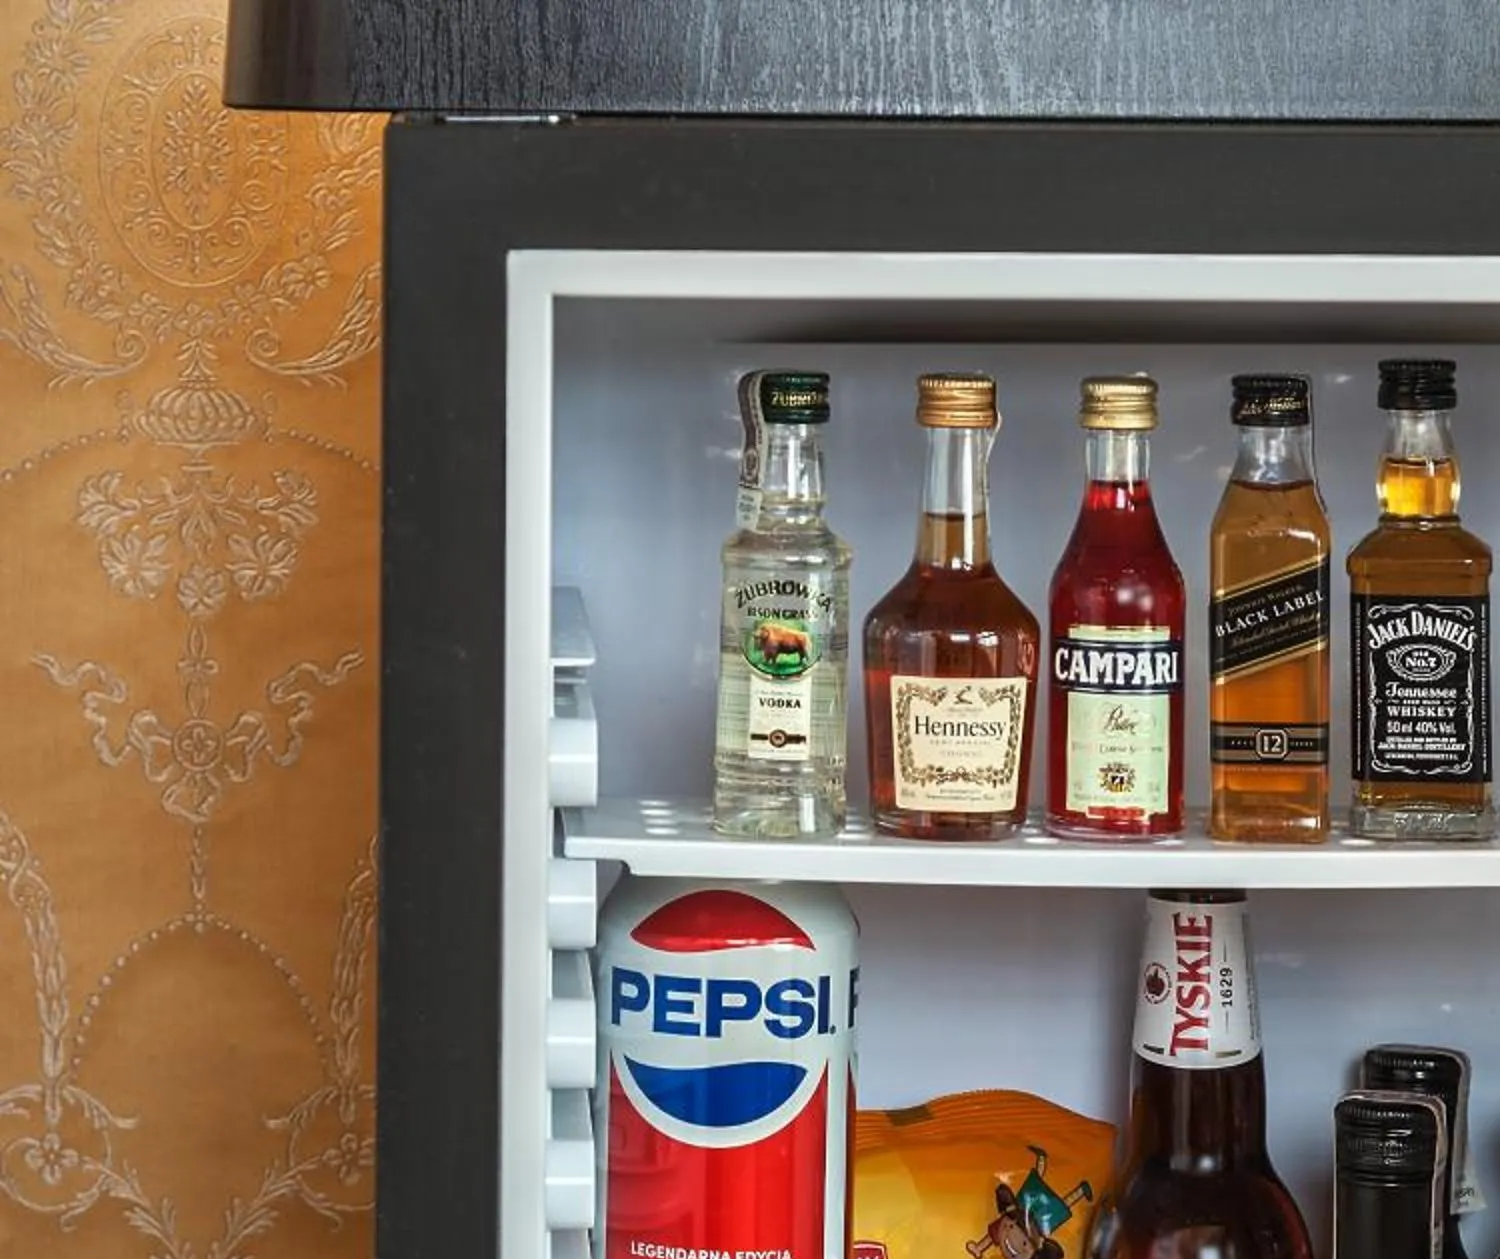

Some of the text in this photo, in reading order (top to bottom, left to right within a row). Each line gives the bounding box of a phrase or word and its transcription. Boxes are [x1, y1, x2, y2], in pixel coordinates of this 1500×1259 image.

[1215, 608, 1270, 637] BLACK
[1273, 589, 1324, 617] LABEL
[1367, 617, 1411, 649] JACK
[1055, 648, 1179, 684] CAMPARI
[758, 697, 802, 709] VODKA
[1387, 705, 1457, 717] WHISKEY
[914, 715, 1007, 741] Hennessy
[1262, 735, 1282, 752] 12
[1169, 912, 1213, 1057] TYSKIE
[1220, 967, 1233, 1008] 1629
